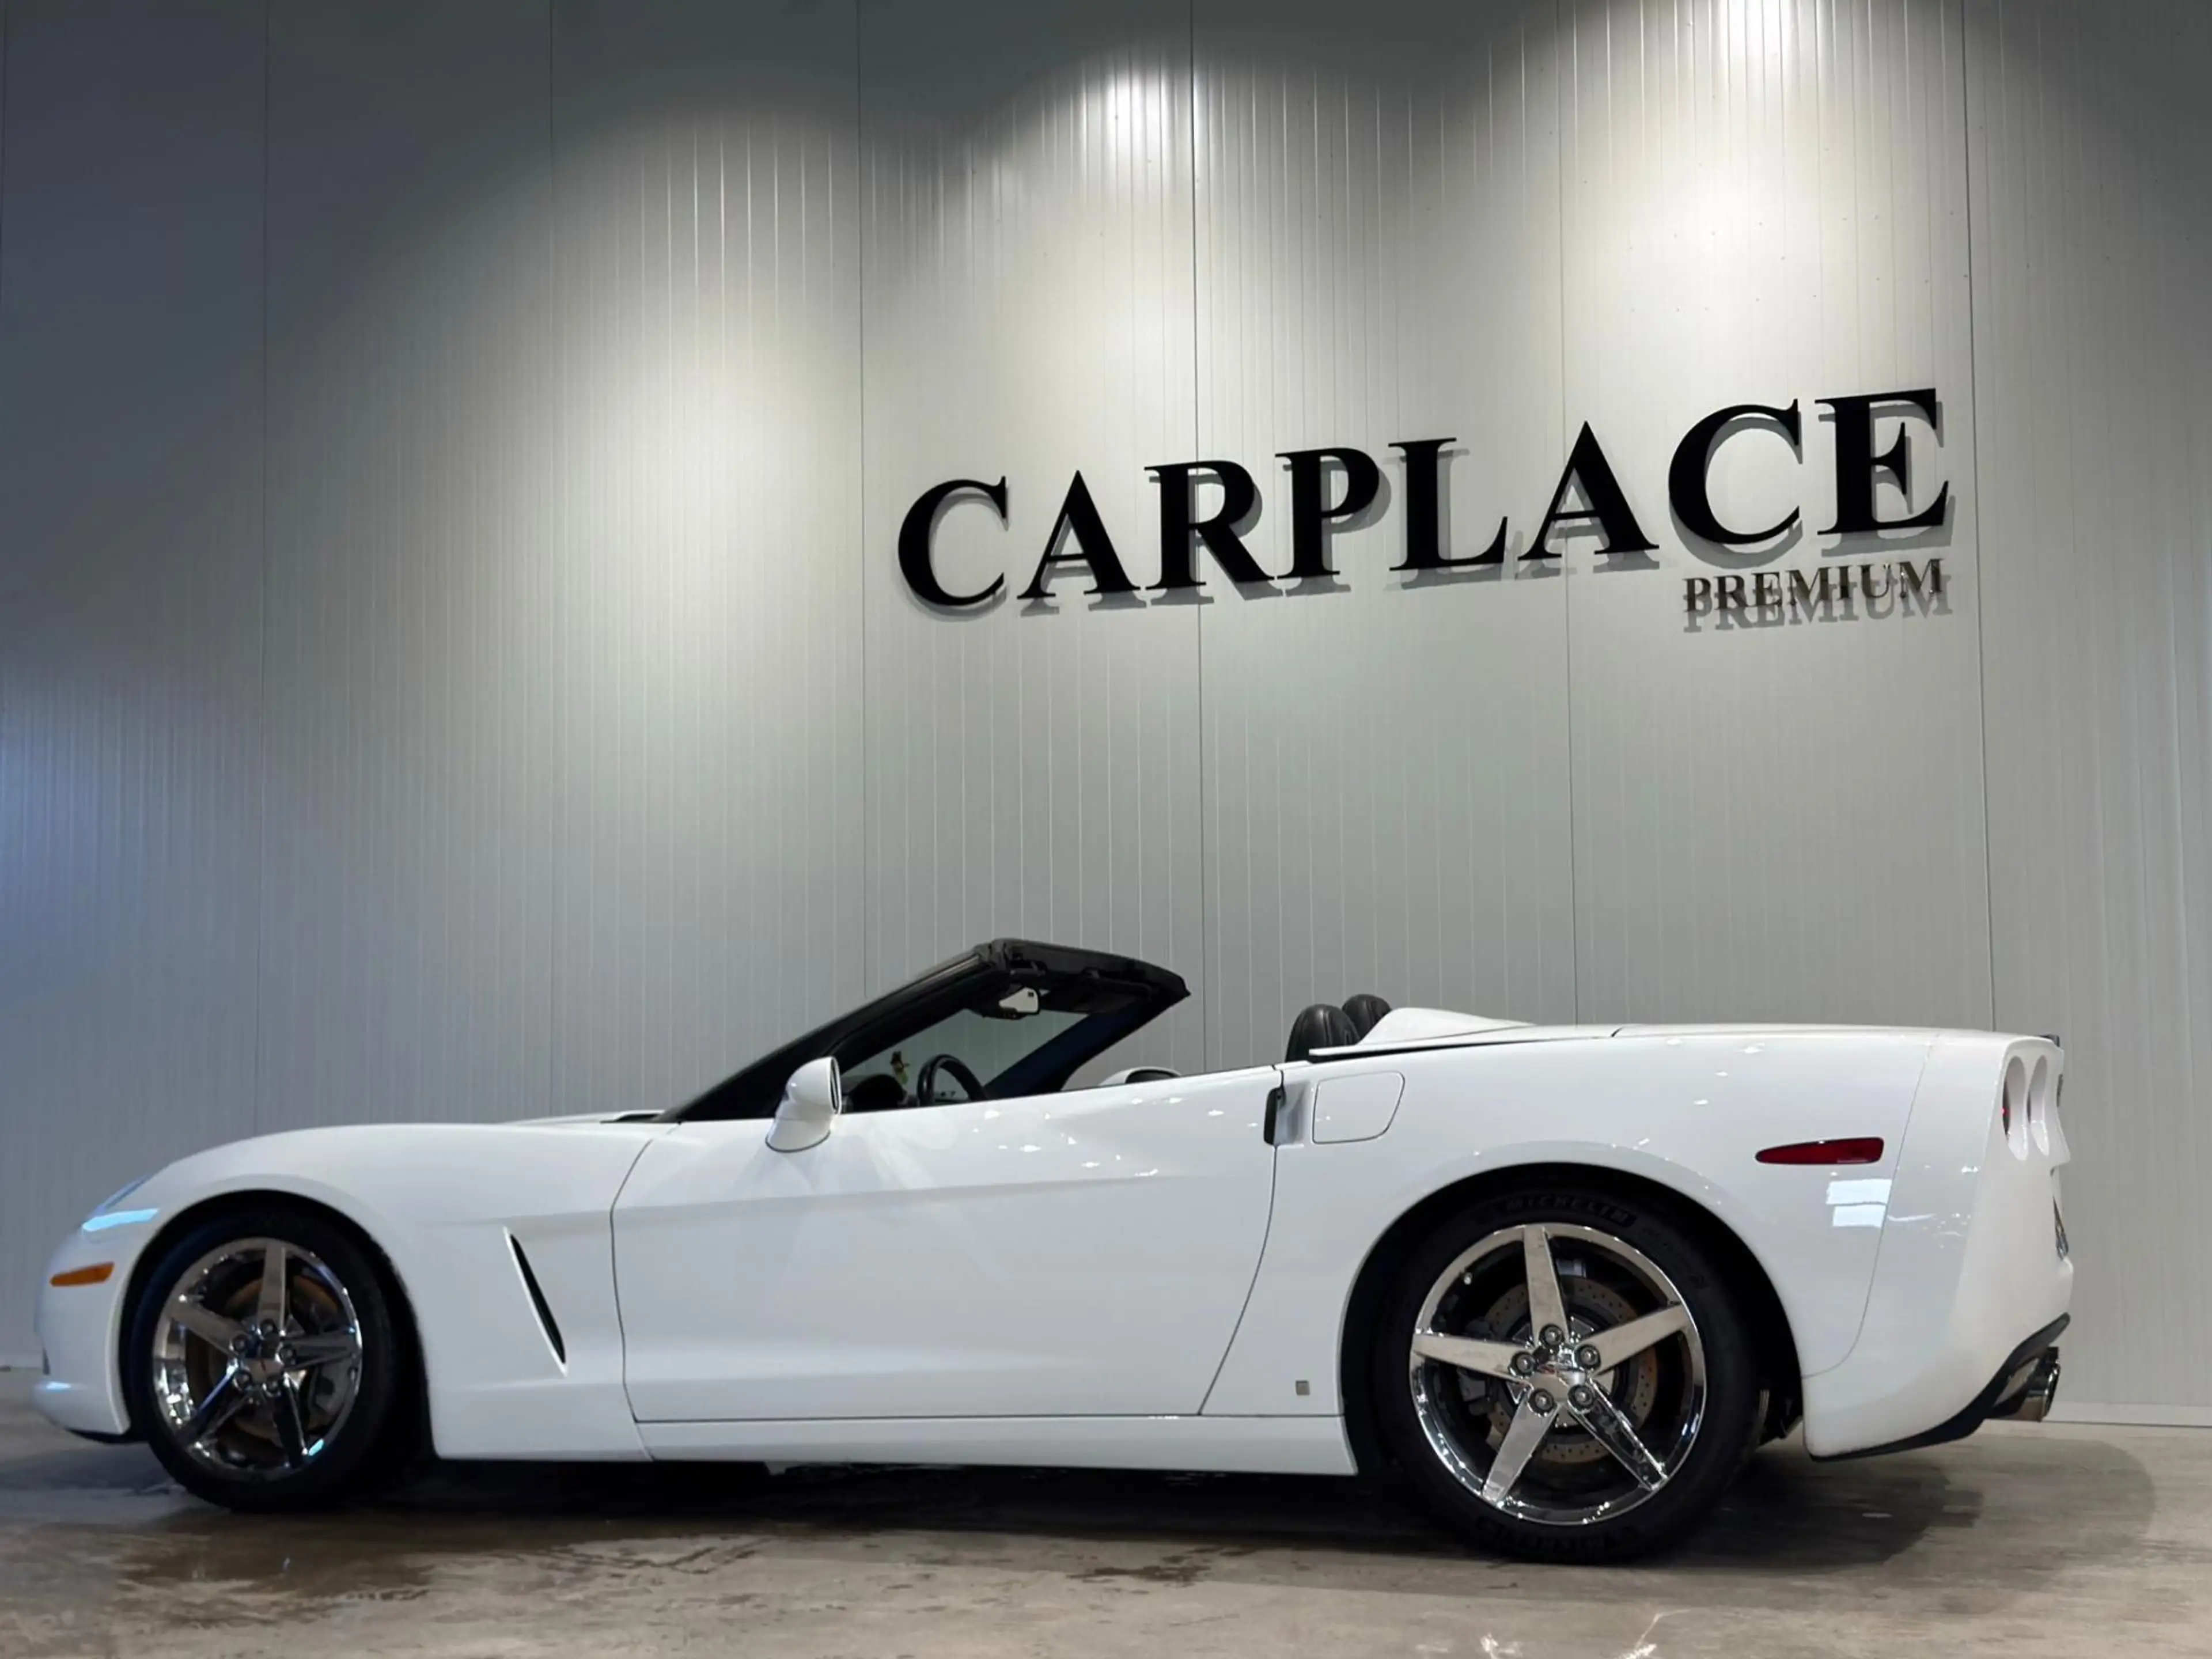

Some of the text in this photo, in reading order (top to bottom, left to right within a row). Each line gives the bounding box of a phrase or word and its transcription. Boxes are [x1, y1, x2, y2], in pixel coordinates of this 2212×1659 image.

[899, 388, 1949, 607] CARPLACE
[1683, 558, 1944, 612] PREMIUM
[1506, 1195, 1629, 1223] MICHELIN
